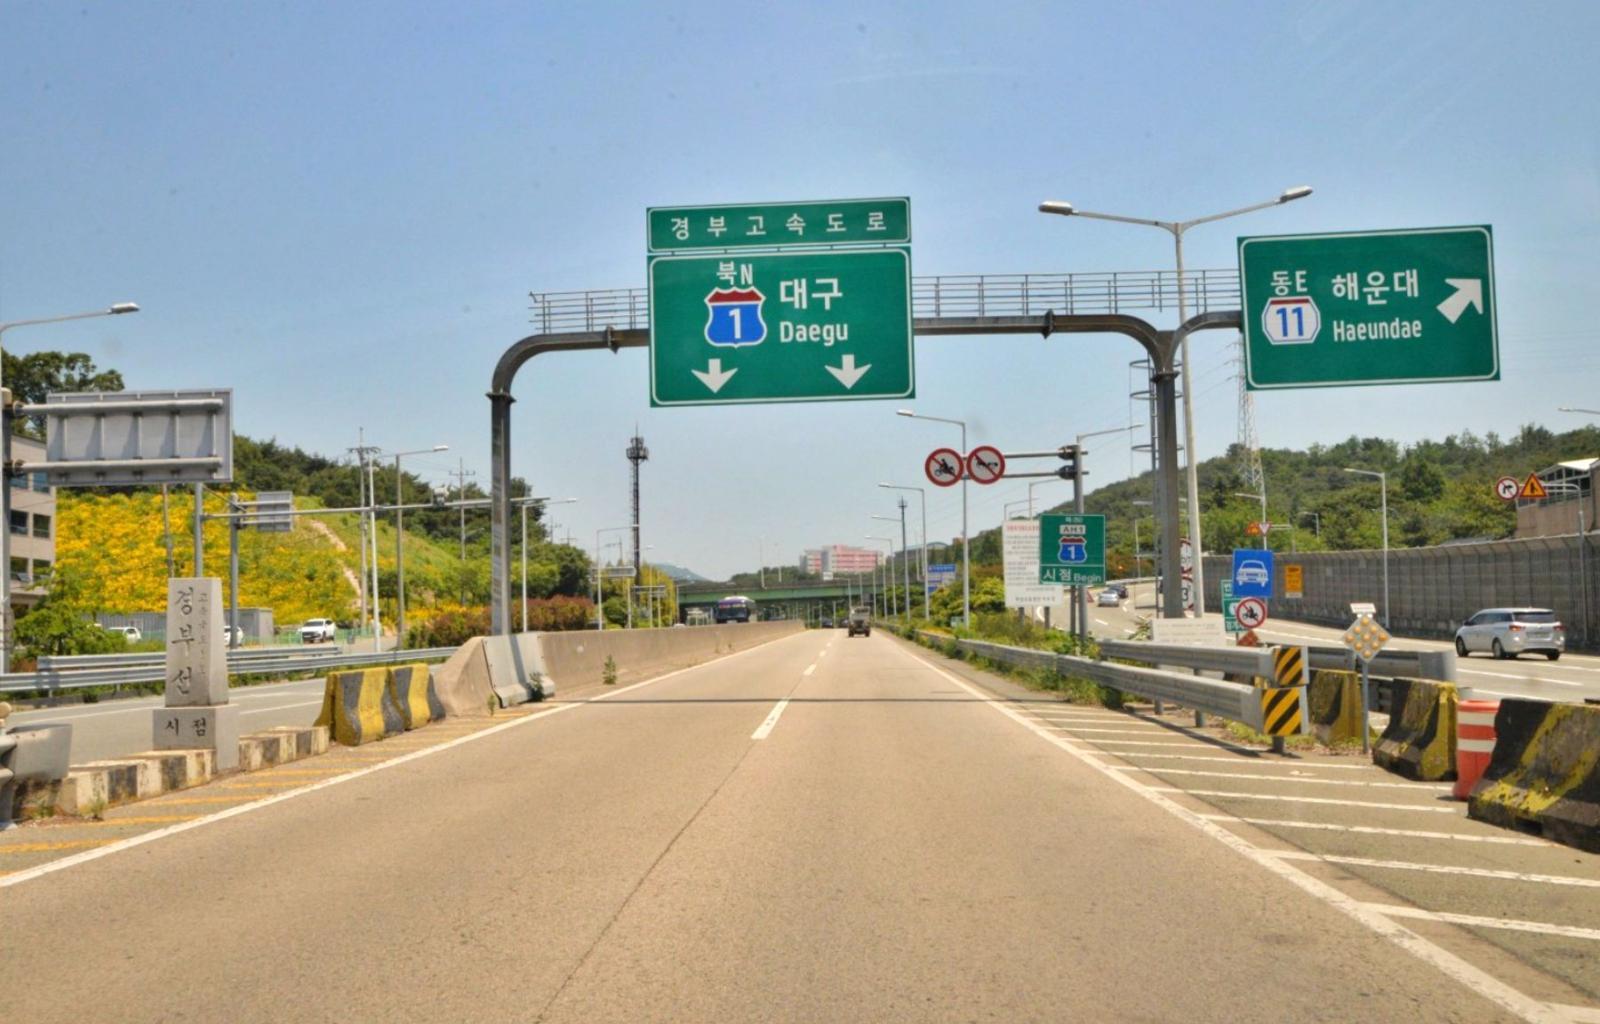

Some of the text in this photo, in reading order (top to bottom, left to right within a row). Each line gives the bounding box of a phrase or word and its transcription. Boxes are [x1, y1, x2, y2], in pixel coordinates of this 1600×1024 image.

[779, 277, 843, 310] 대구
[1331, 269, 1419, 305] 해운대
[728, 308, 742, 339] 1
[779, 320, 849, 347] Daegu
[1275, 306, 1304, 337] 11
[1333, 317, 1422, 342] Haeundae
[1067, 545, 1075, 560] 1
[165, 717, 208, 737] 시점
